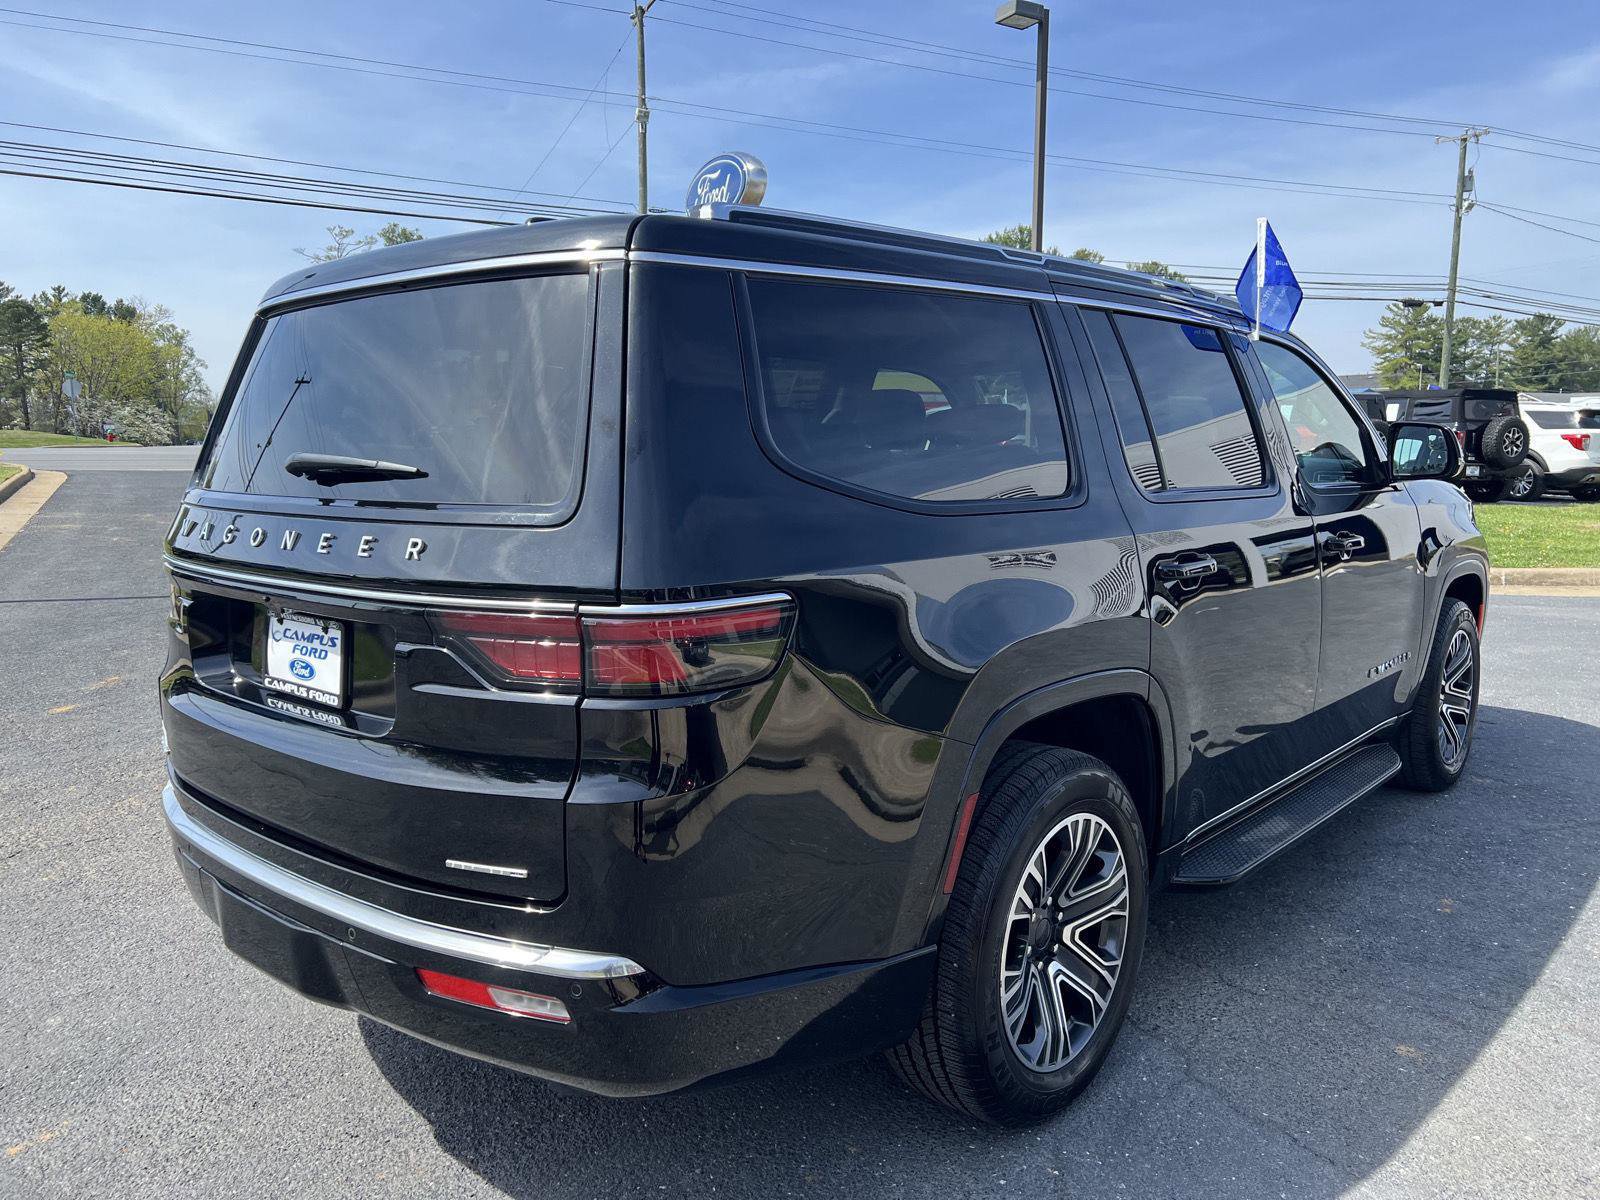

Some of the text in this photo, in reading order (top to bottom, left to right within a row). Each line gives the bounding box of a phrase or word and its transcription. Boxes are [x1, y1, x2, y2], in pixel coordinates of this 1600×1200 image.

[694, 169, 731, 204] Ford
[181, 518, 427, 561] WAGONEER
[282, 627, 339, 648] CAMPUS
[292, 643, 329, 660] FORD
[264, 677, 339, 706] CAMPUS FORD
